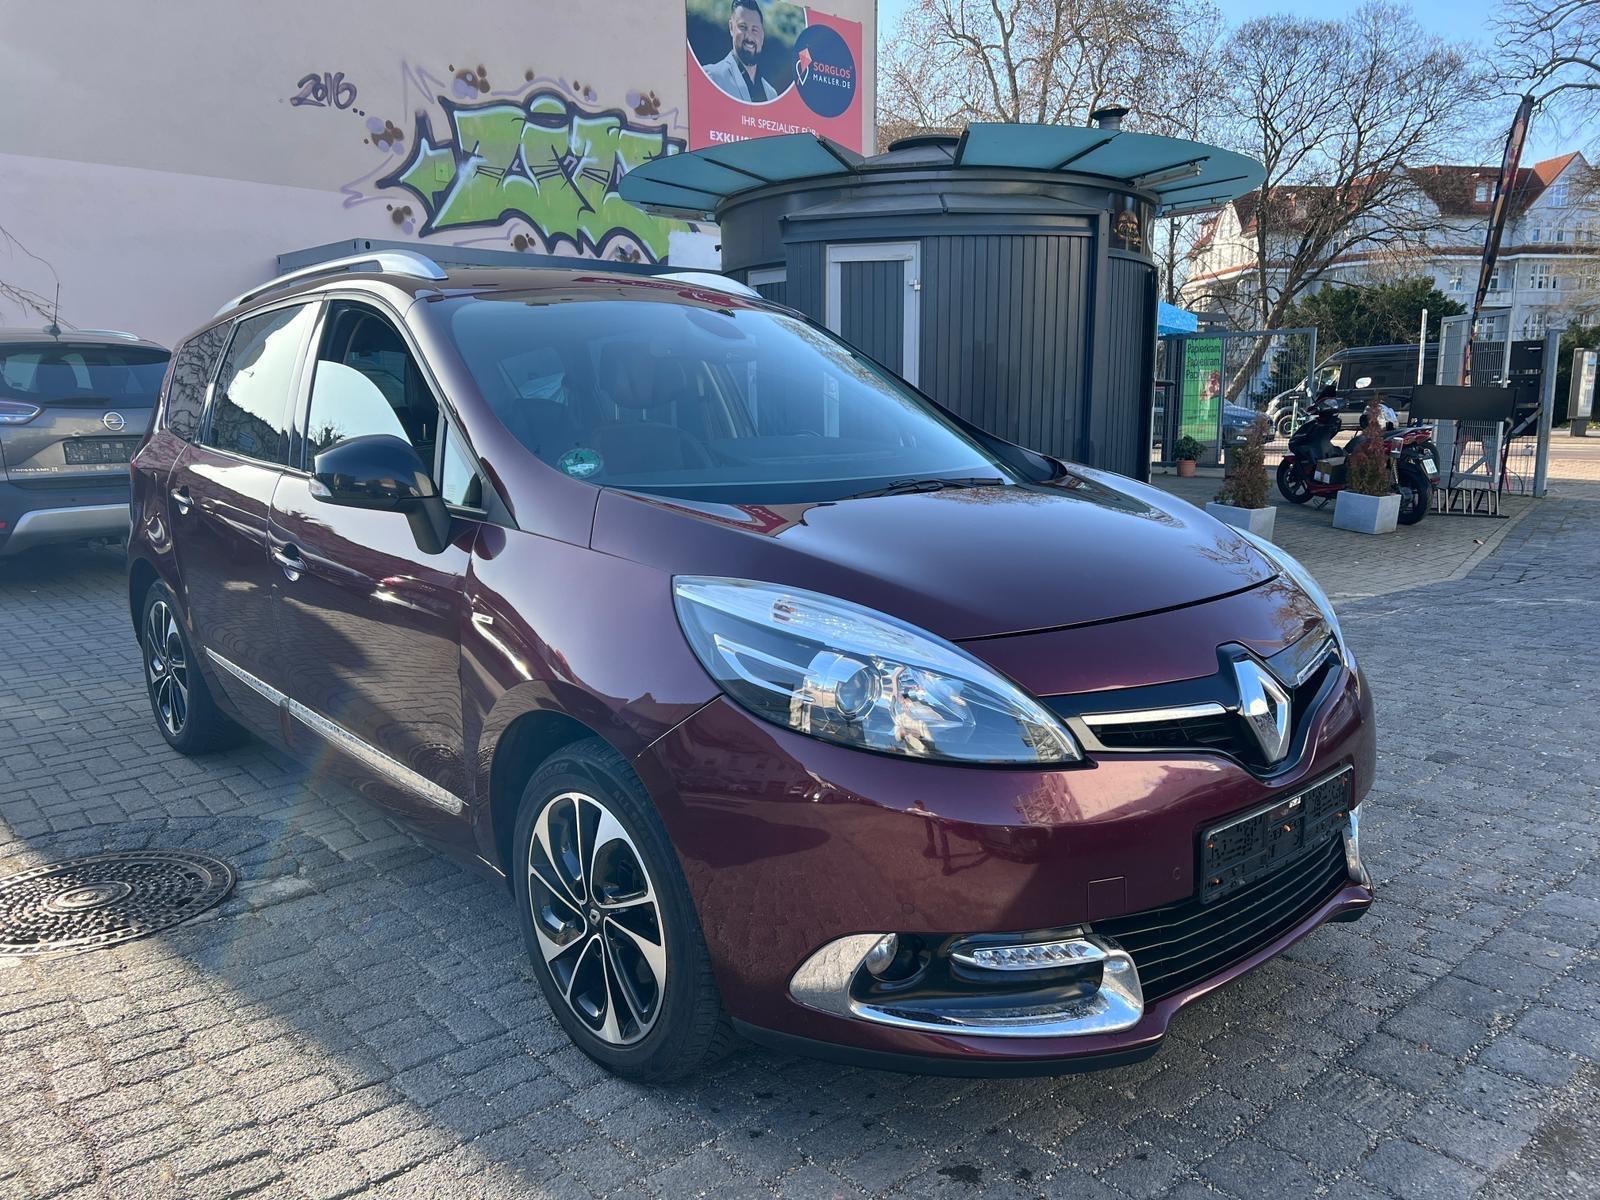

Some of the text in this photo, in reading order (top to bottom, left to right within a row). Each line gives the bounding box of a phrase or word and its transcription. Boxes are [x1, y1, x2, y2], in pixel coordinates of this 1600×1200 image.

[812, 61, 851, 79] SORGLOS
[812, 73, 851, 89] MAKLER.DE
[289, 71, 357, 110] 2016
[741, 114, 756, 127] IHR
[757, 118, 800, 135] SPEZIALIST
[709, 129, 752, 143] EXKLU
